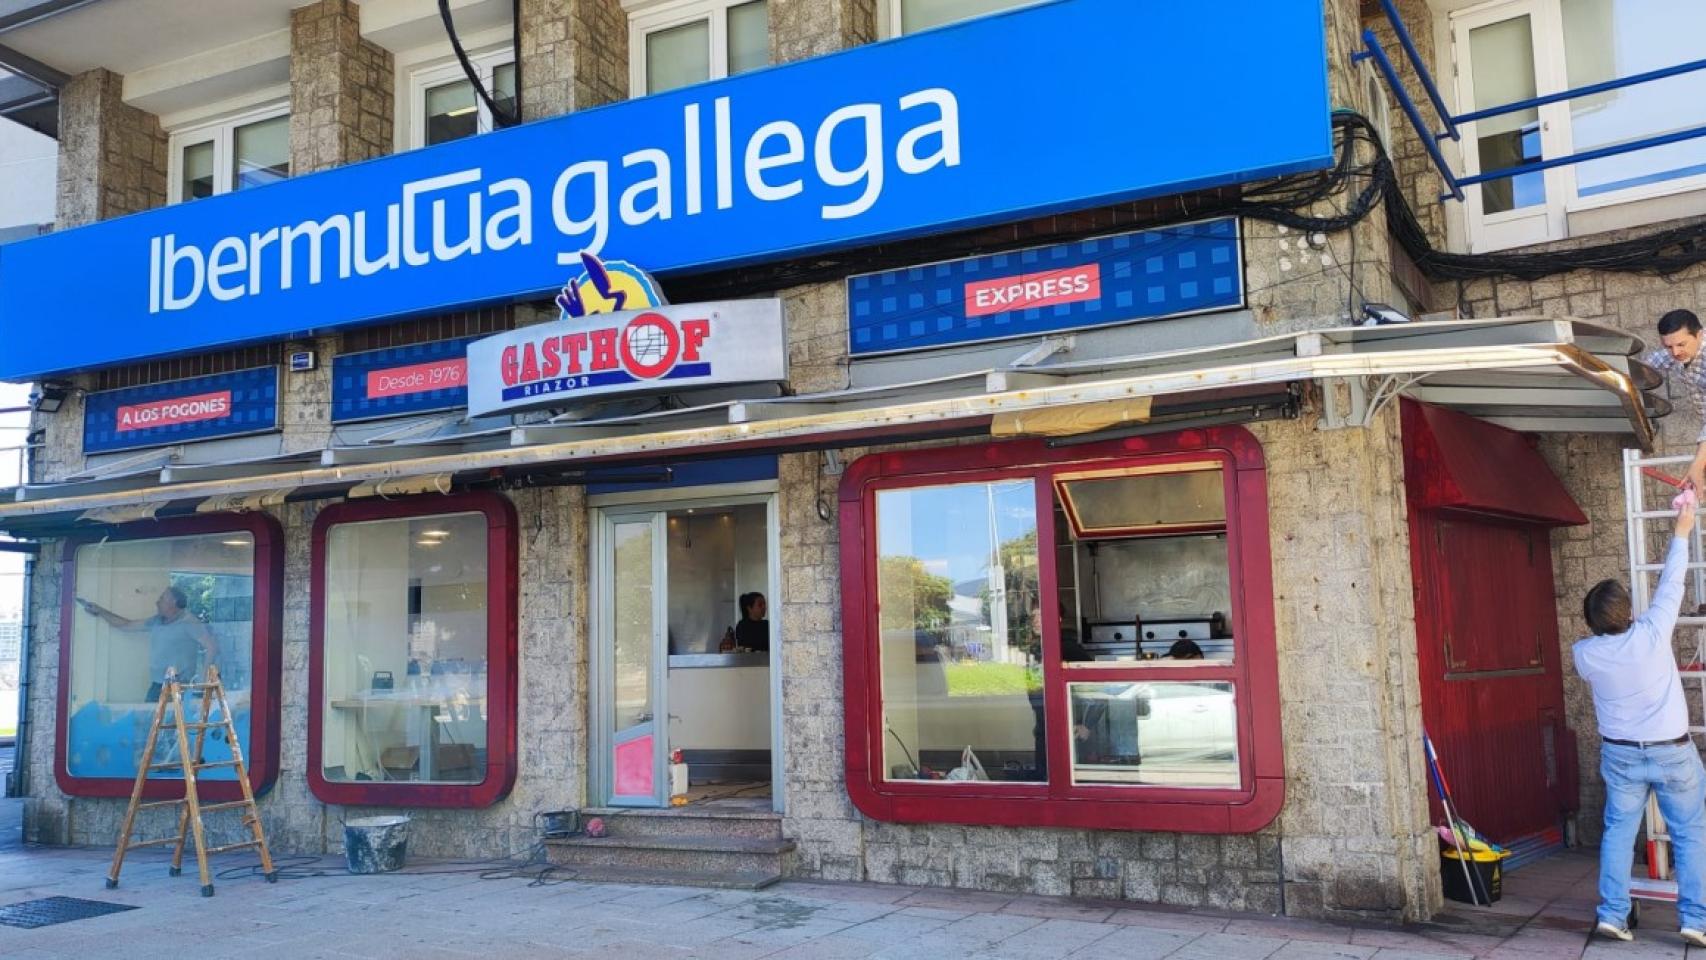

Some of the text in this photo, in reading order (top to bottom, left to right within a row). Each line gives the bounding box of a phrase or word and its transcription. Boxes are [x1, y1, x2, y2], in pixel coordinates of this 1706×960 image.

[552, 88, 961, 266] gallega
[975, 274, 1091, 308] EXPRESS
[501, 312, 711, 387] GASTHOF
[378, 364, 461, 391] Desde 1976
[524, 376, 590, 396] RIAZOR
[122, 398, 226, 425] A LOS FOGONES
